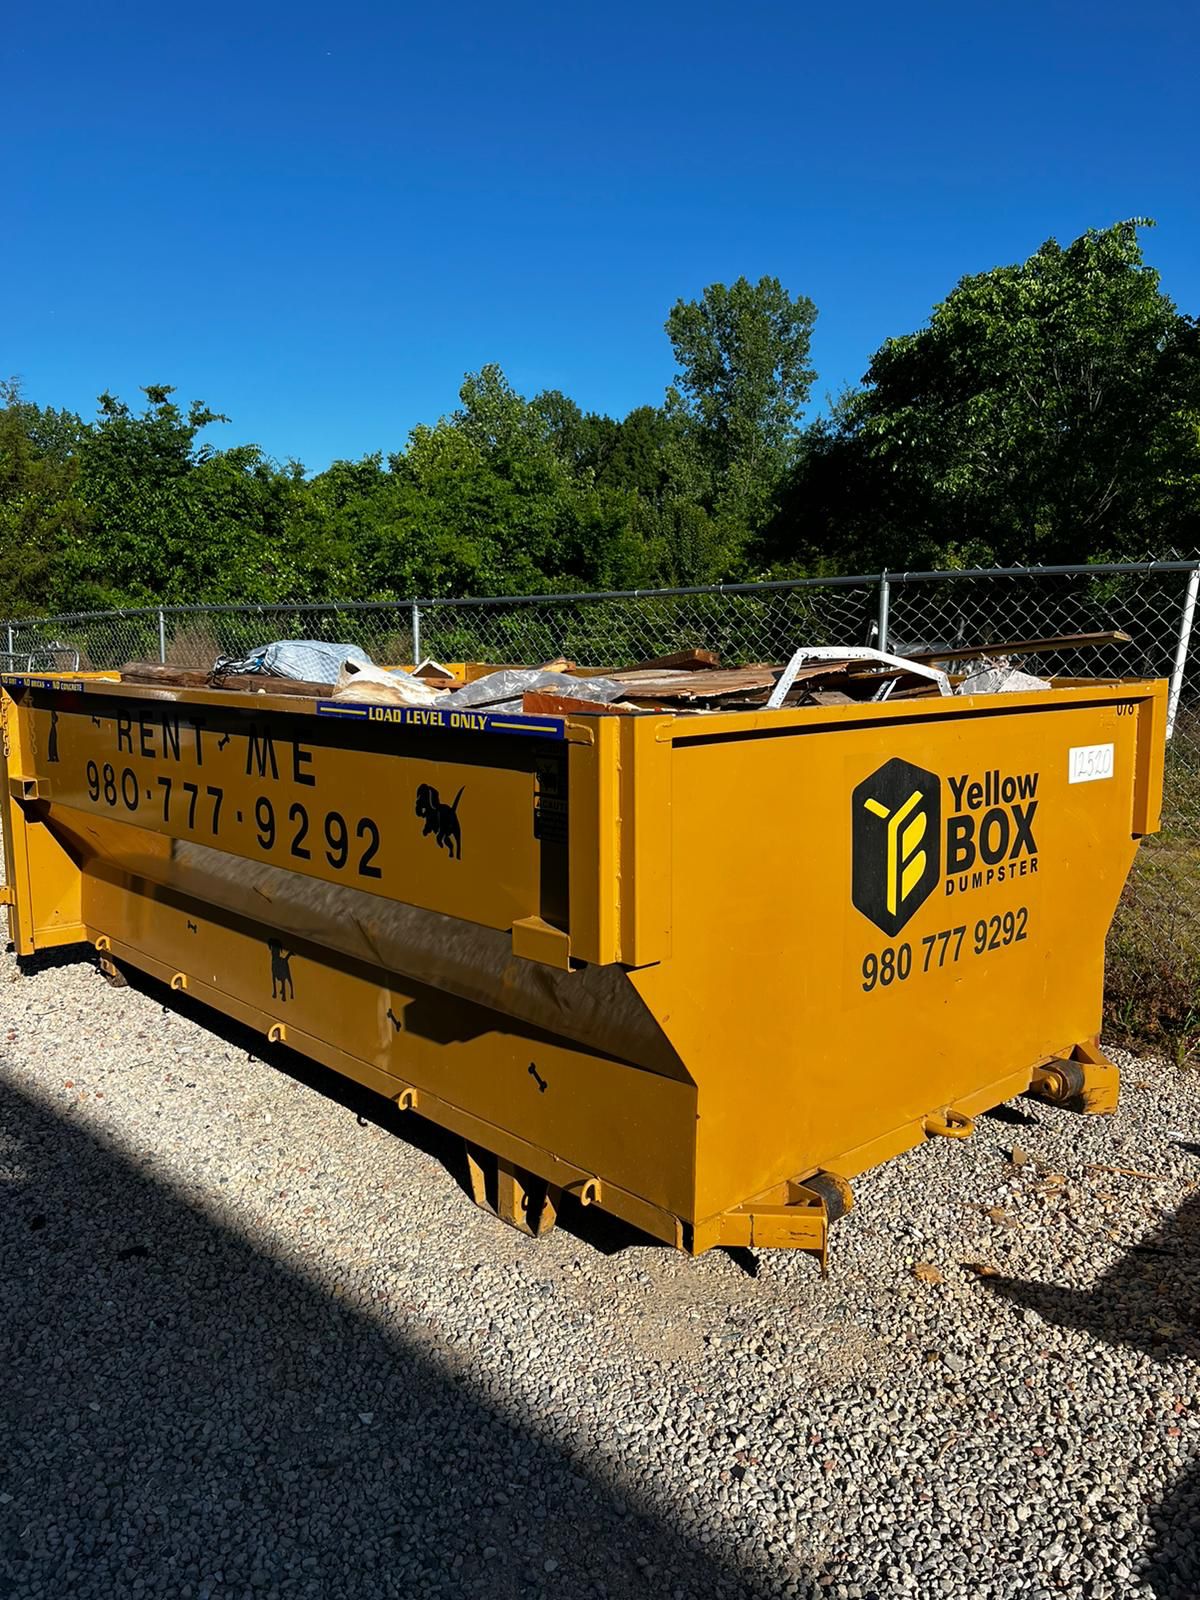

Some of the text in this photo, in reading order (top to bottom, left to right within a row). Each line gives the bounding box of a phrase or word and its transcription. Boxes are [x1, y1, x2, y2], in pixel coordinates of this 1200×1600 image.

[368, 706, 488, 730] LOAD LEVEL ONLY
[117, 709, 316, 787] RENT ME
[1073, 748, 1112, 778] 12520
[947, 770, 1039, 813] Yellow
[945, 800, 1039, 877] BOX
[945, 857, 1038, 896] DUMPSTER
[861, 906, 1029, 993] 980 777 9292
